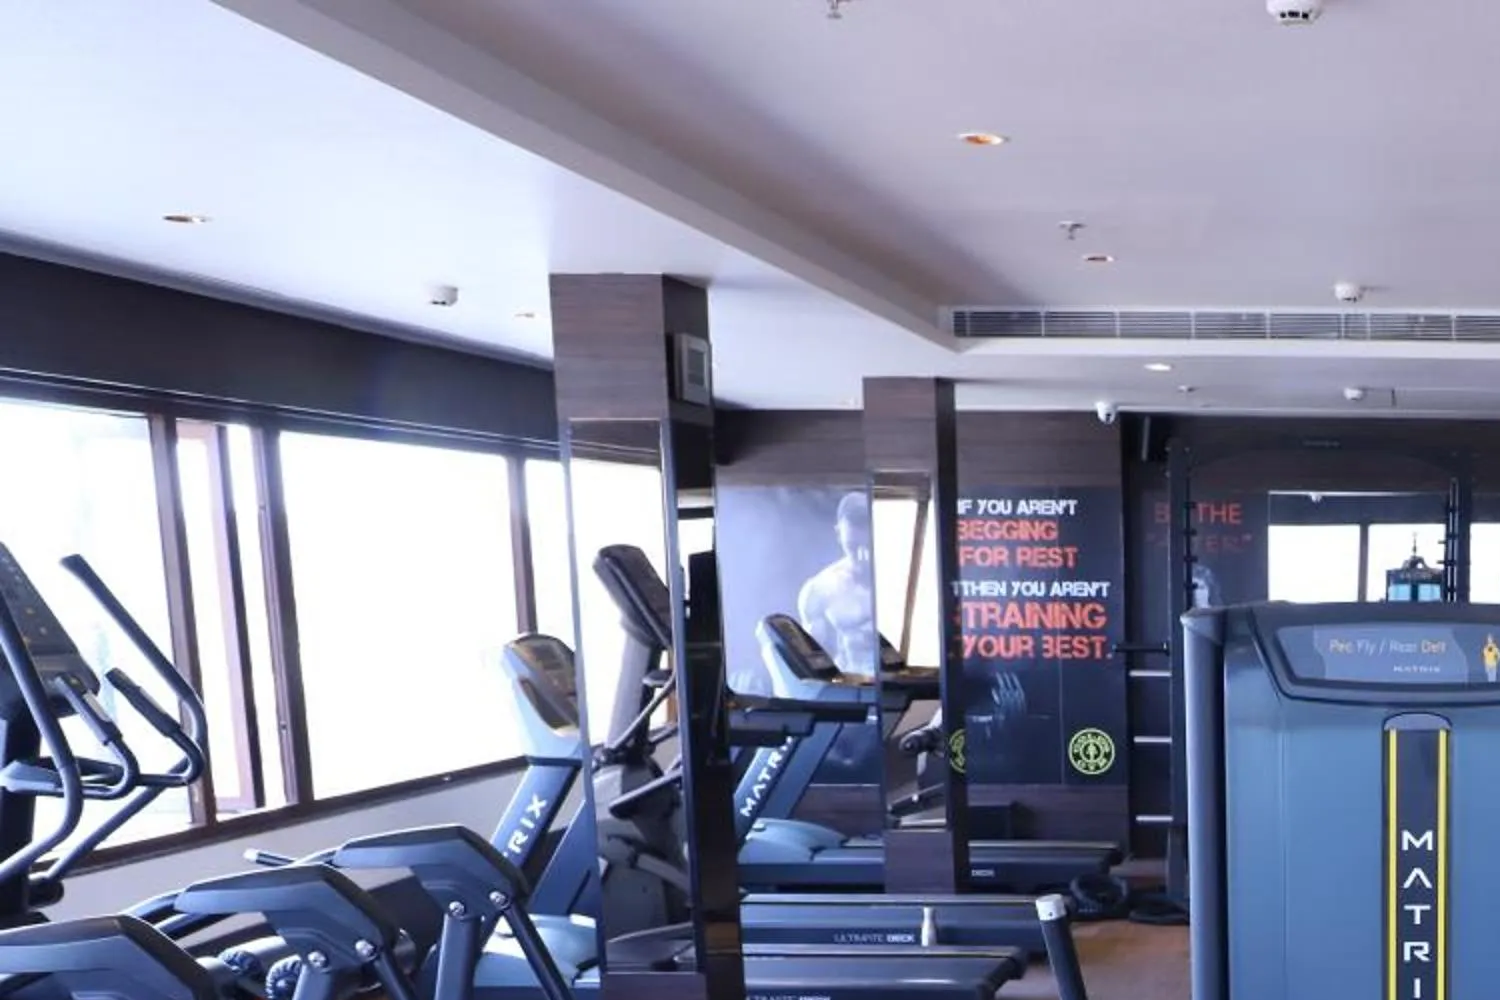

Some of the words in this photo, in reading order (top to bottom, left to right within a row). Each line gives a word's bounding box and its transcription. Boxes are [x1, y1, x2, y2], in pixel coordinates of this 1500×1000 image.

[957, 499, 972, 516] IF
[977, 499, 1012, 516] YOU
[1016, 499, 1078, 516] AREN'T
[1198, 502, 1242, 524] THE
[957, 519, 1059, 541] BEGGING
[959, 546, 1009, 568] FOR
[1016, 546, 1078, 568] REST
[960, 580, 1007, 597] THEN
[1011, 581, 1046, 597] YOU
[1050, 581, 1110, 597] AREN'T
[962, 602, 1107, 629] TRAINING
[962, 635, 1035, 660] YOUR
[1042, 635, 1113, 660] BEST.
[740, 735, 793, 817] MATR
[503, 793, 547, 858] RIX
[886, 933, 916, 943] DECK
